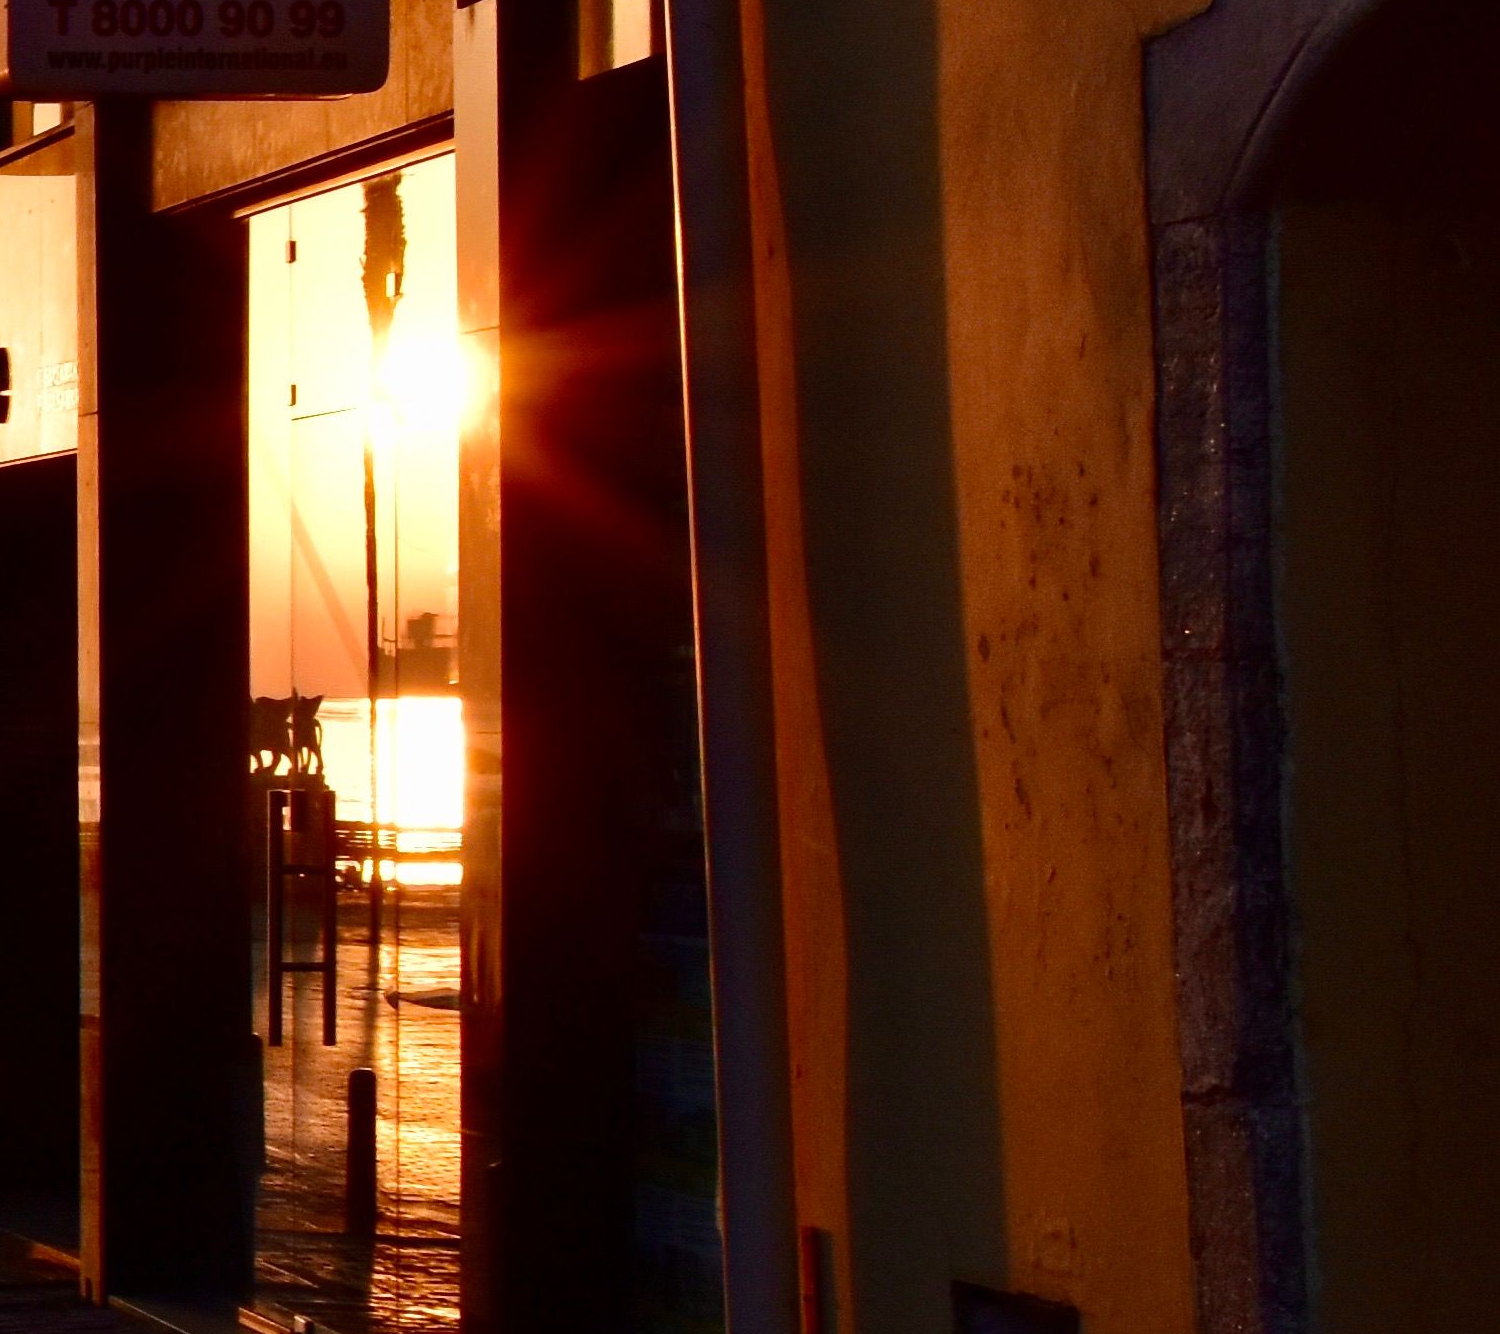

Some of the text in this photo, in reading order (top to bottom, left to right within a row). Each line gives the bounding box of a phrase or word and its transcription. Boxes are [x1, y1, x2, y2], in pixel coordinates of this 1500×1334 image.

[218, 0, 274, 37] 90
[288, 0, 345, 37] 99
[47, 47, 348, 73] www.purpleinternational.eu
